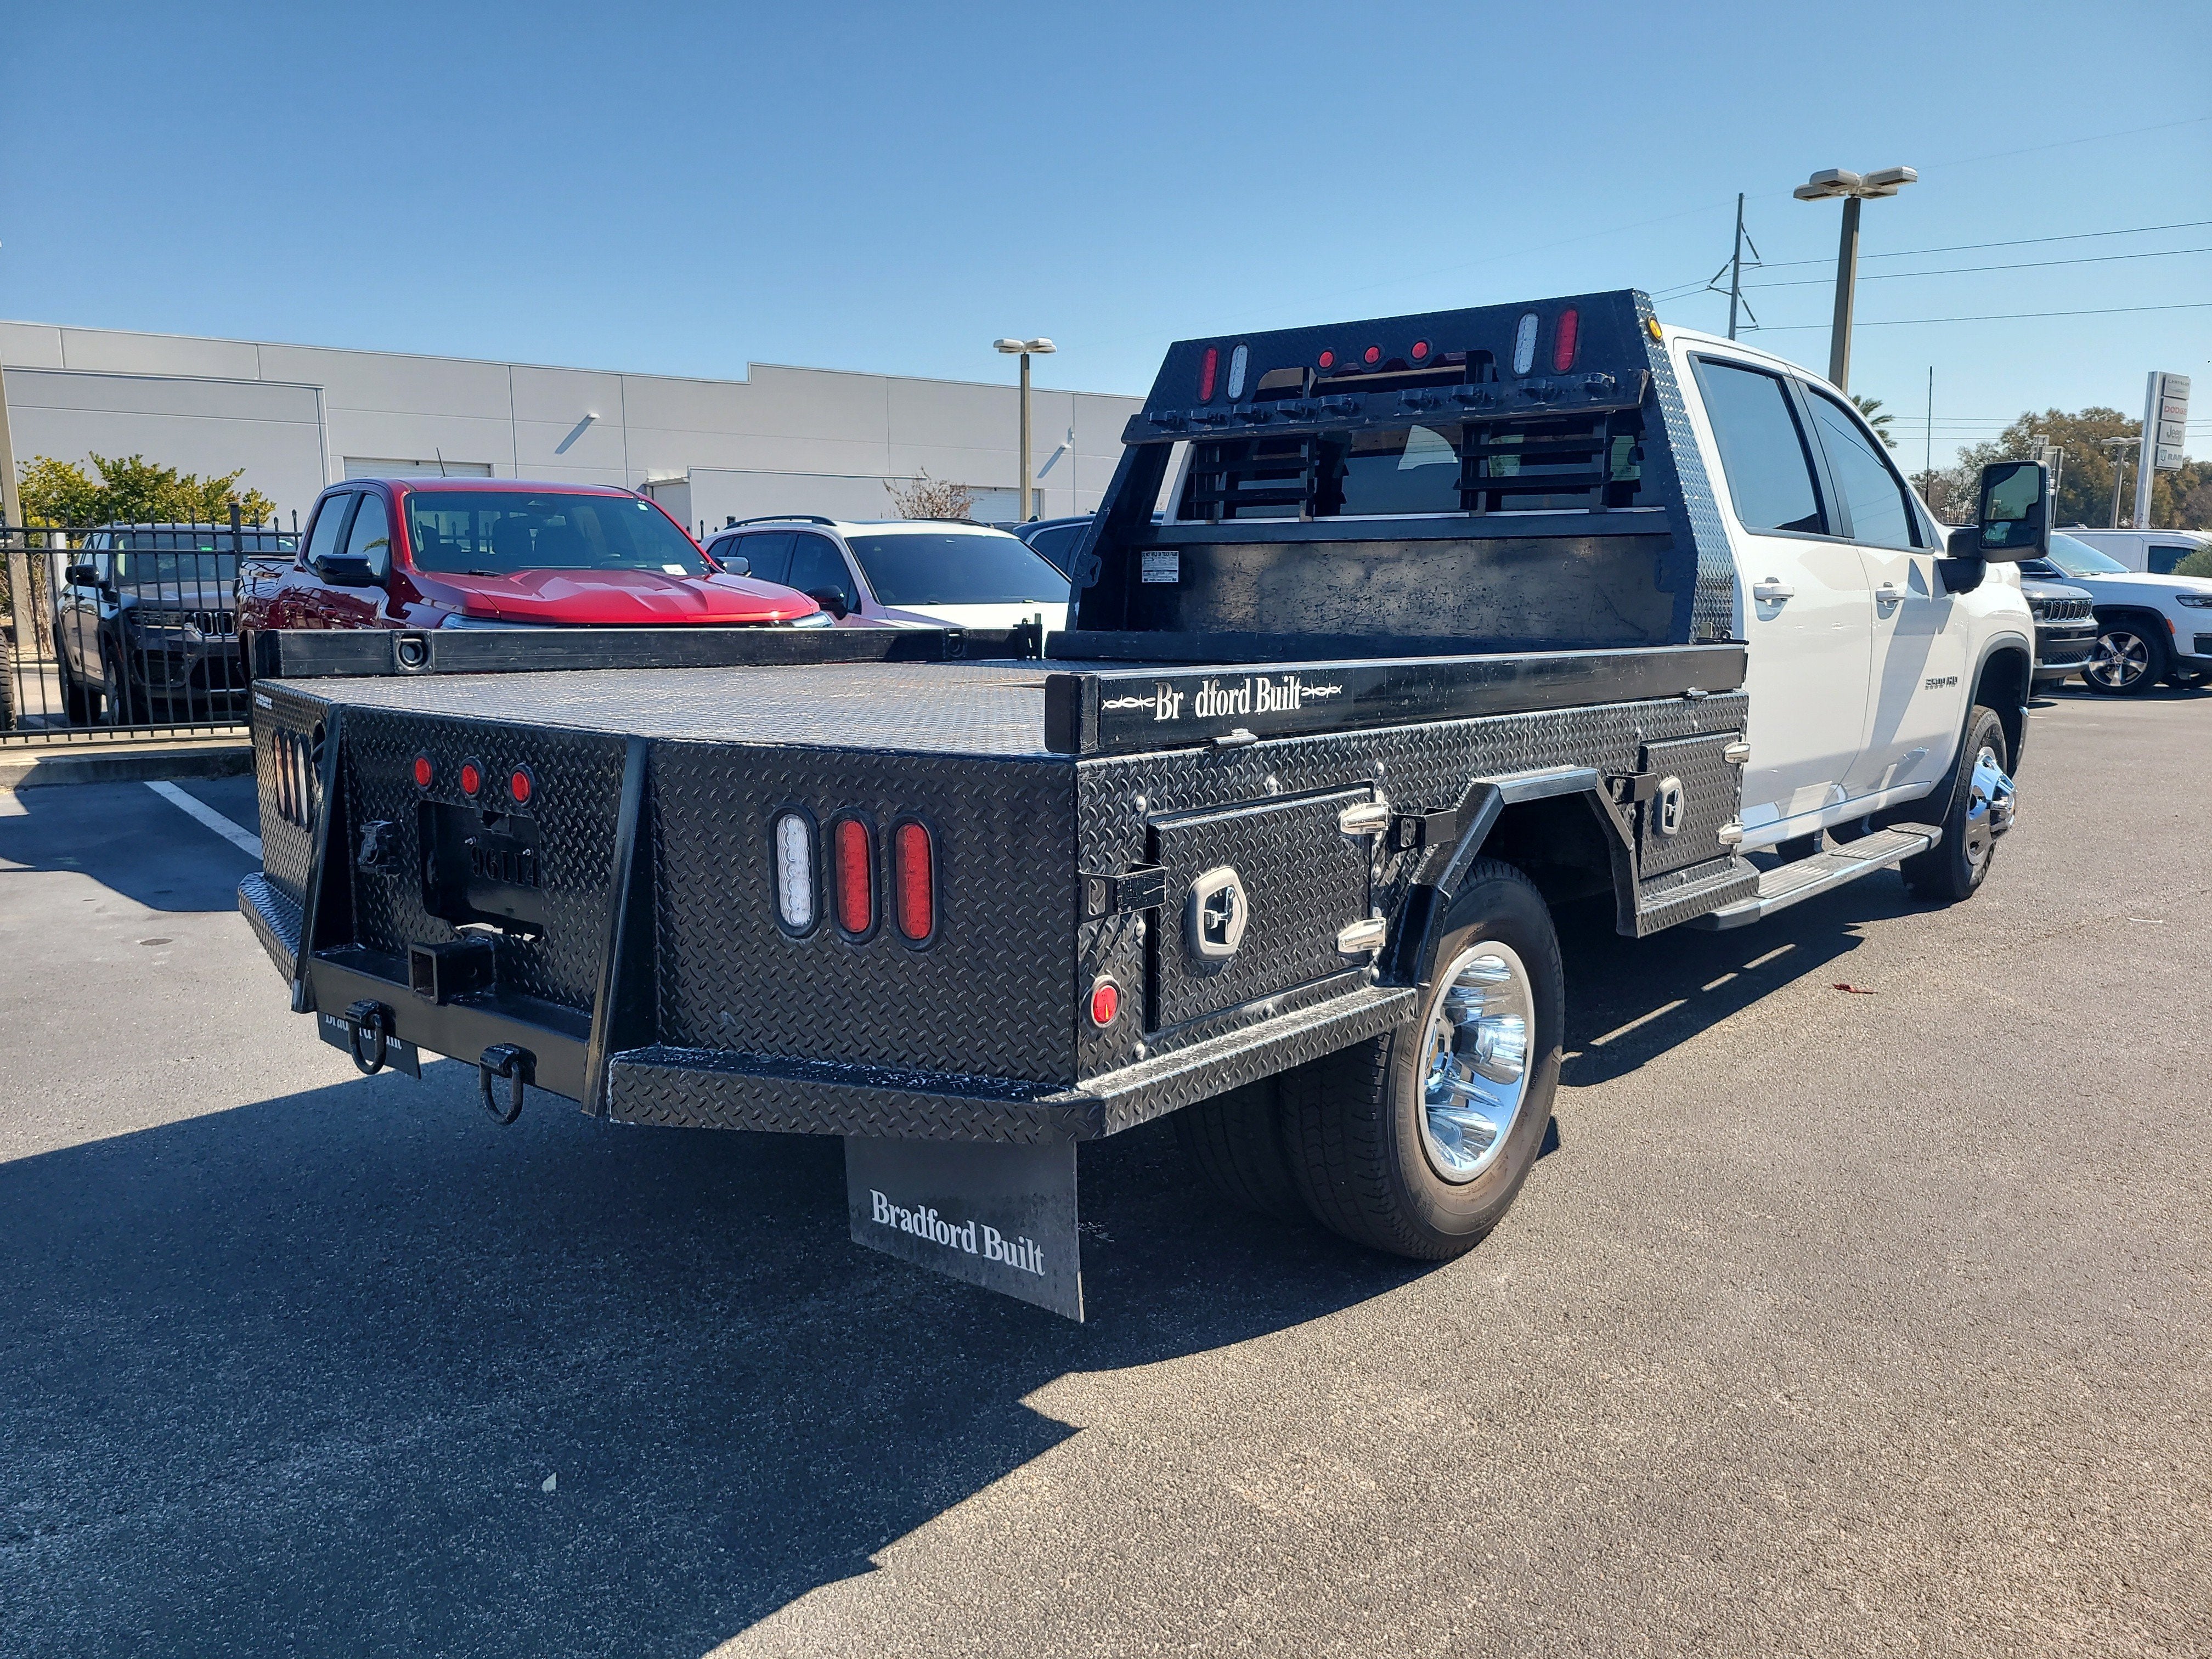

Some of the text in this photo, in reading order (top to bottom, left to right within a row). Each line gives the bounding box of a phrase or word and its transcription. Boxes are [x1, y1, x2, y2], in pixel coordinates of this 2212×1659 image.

[2164, 405, 2187, 415] DODGE
[2166, 425, 2182, 442] Jeep
[1254, 675, 1302, 714] Built
[870, 1188, 1046, 1277] Bradford Built
